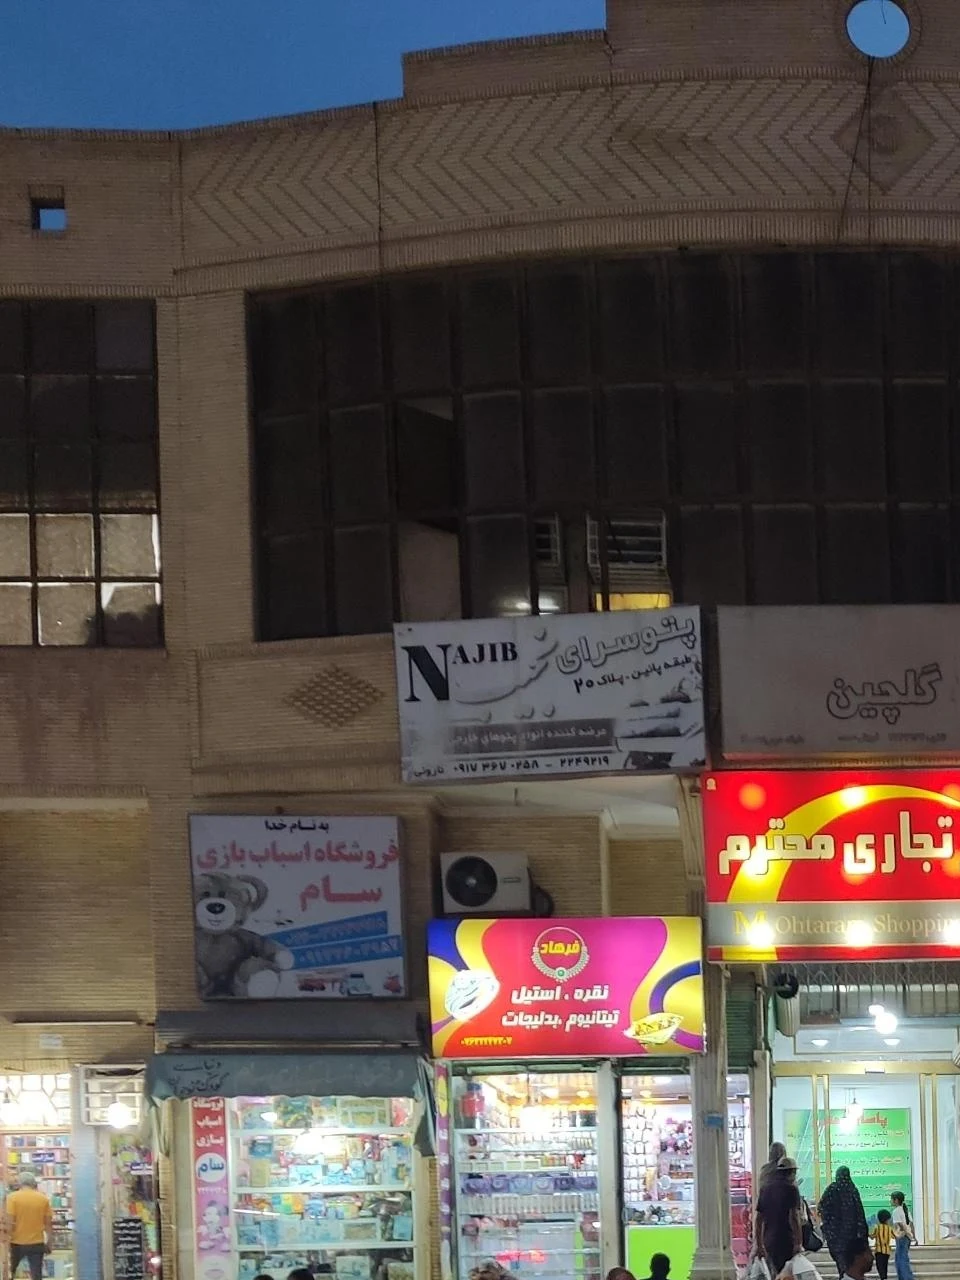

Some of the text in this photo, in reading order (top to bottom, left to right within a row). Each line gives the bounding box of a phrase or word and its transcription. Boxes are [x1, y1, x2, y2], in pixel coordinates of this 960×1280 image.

[556, 616, 697, 674] پتوسرای
[401, 642, 518, 702] NAJIB
[664, 655, 692, 669] طبقه
[597, 673, 625, 686] پلاک
[826, 662, 944, 725] گلچین
[264, 818, 330, 834] به نام خدا
[196, 838, 401, 871] فروشگاه اسباب بازی
[718, 817, 836, 876] محترم
[843, 811, 954, 875] تجاری
[298, 874, 383, 912] سام
[539, 941, 581, 956] فرهاد
[511, 986, 609, 1004] نقره استیل
[564, 1009, 620, 1032] تیتانیوم
[197, 1158, 225, 1178] سام
